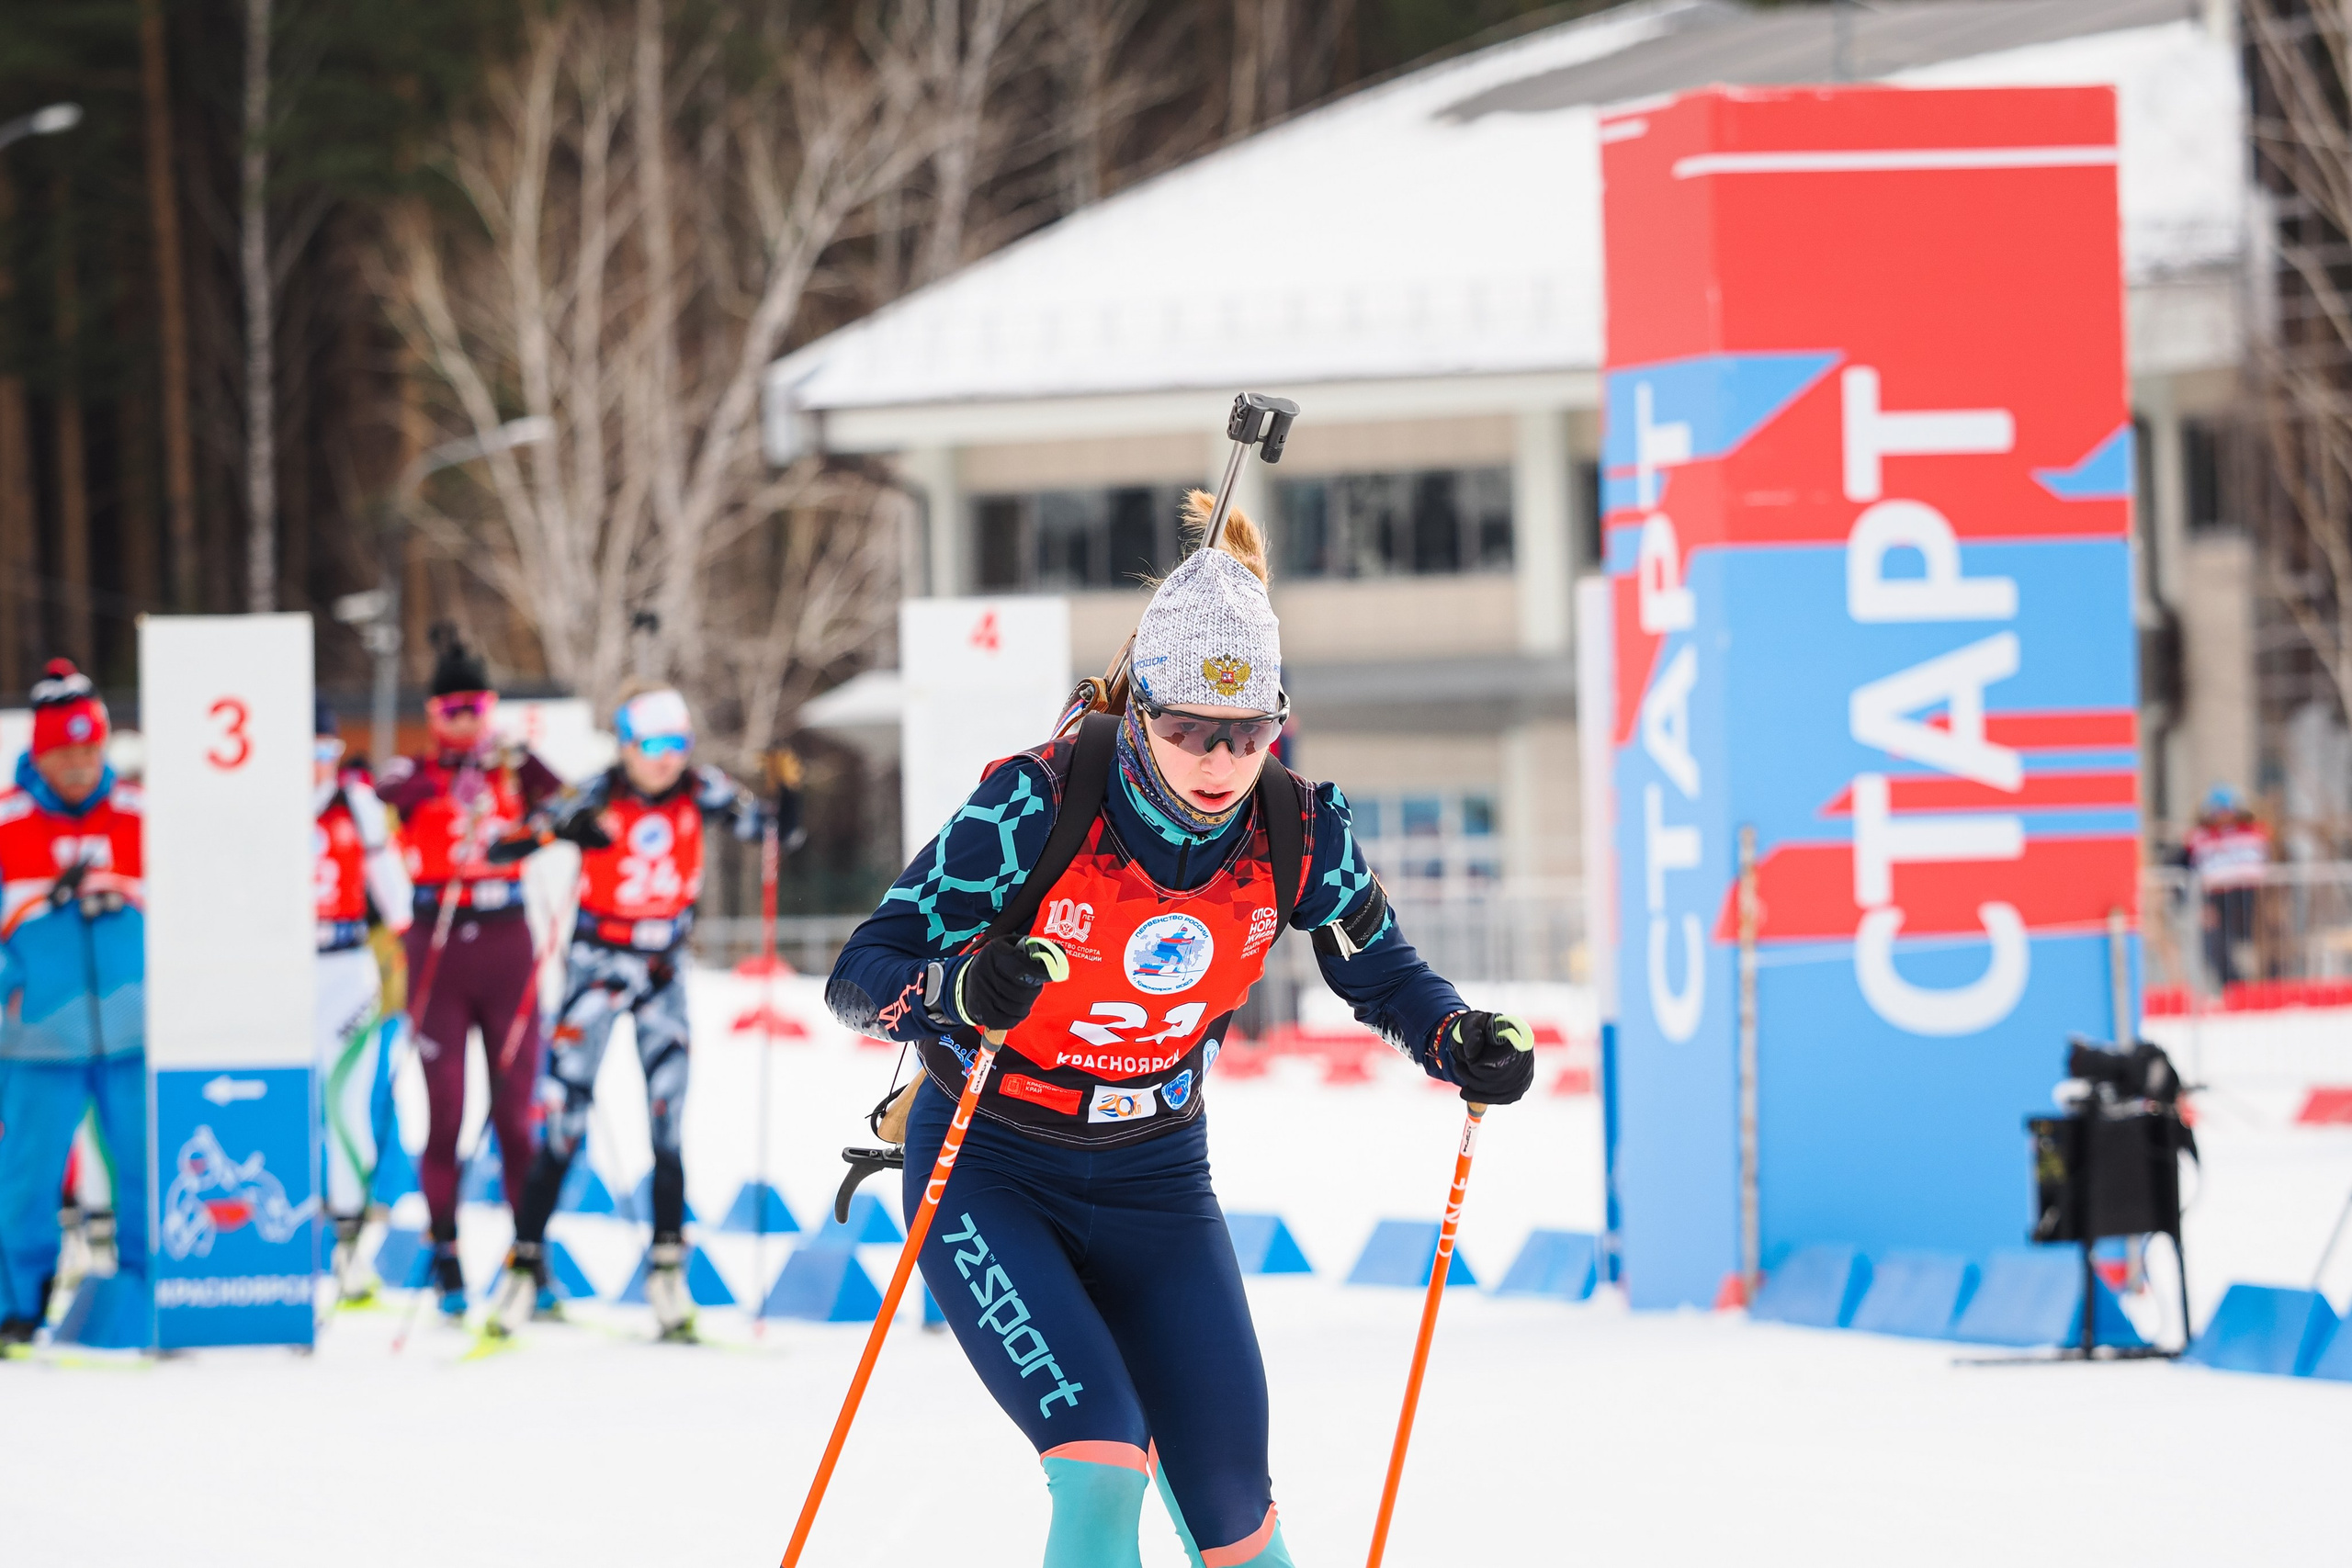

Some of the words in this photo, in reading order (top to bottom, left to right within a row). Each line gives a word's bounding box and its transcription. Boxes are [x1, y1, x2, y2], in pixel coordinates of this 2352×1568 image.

[968, 609, 1002, 655] 4
[1133, 656, 1168, 671] ТОДОР
[1634, 379, 1705, 1044] СТАРТ
[1839, 365, 2030, 1038] СТАРТ
[206, 694, 254, 773] 3
[615, 854, 681, 907] 24
[1081, 914, 1095, 922] ЛЕТ
[1135, 915, 1183, 938] ПЕРВЕНСТВО
[1184, 918, 1209, 939] РОССИИ
[1065, 949, 1102, 963] ФЕДЕРАЦИИ
[1077, 945, 1101, 956] СПОРТА
[1069, 1001, 1208, 1046] 21
[1057, 1048, 1182, 1074] КРАСНОЯРСК
[1025, 1086, 1043, 1094] КРАЙ
